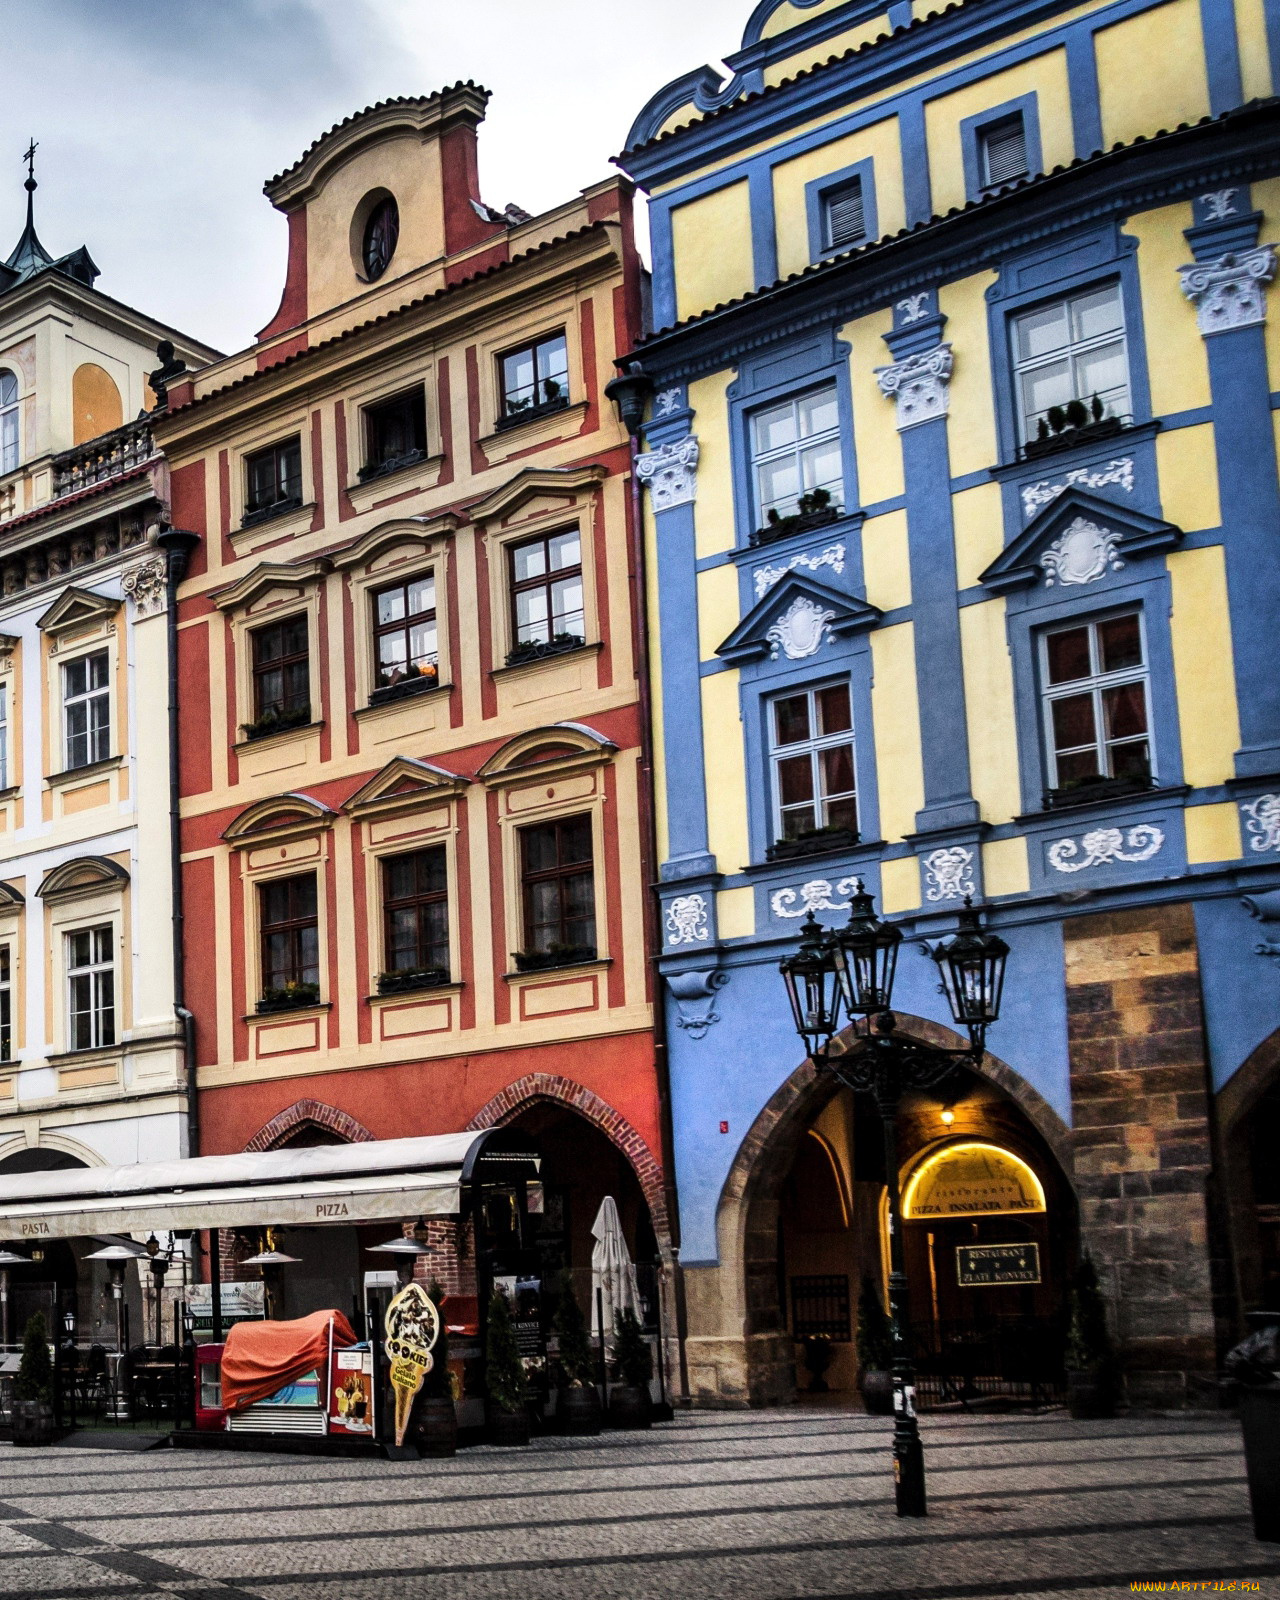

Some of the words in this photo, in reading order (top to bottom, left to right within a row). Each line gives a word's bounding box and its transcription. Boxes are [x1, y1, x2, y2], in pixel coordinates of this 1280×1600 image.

[316, 1203, 349, 1217] PIZZA
[912, 1205, 942, 1215] PIZZA
[949, 1201, 1002, 1213] INSALATA
[22, 1222, 50, 1235] PASTA
[388, 1341, 428, 1367] COOKIES
[395, 1366, 416, 1381] Gelato
